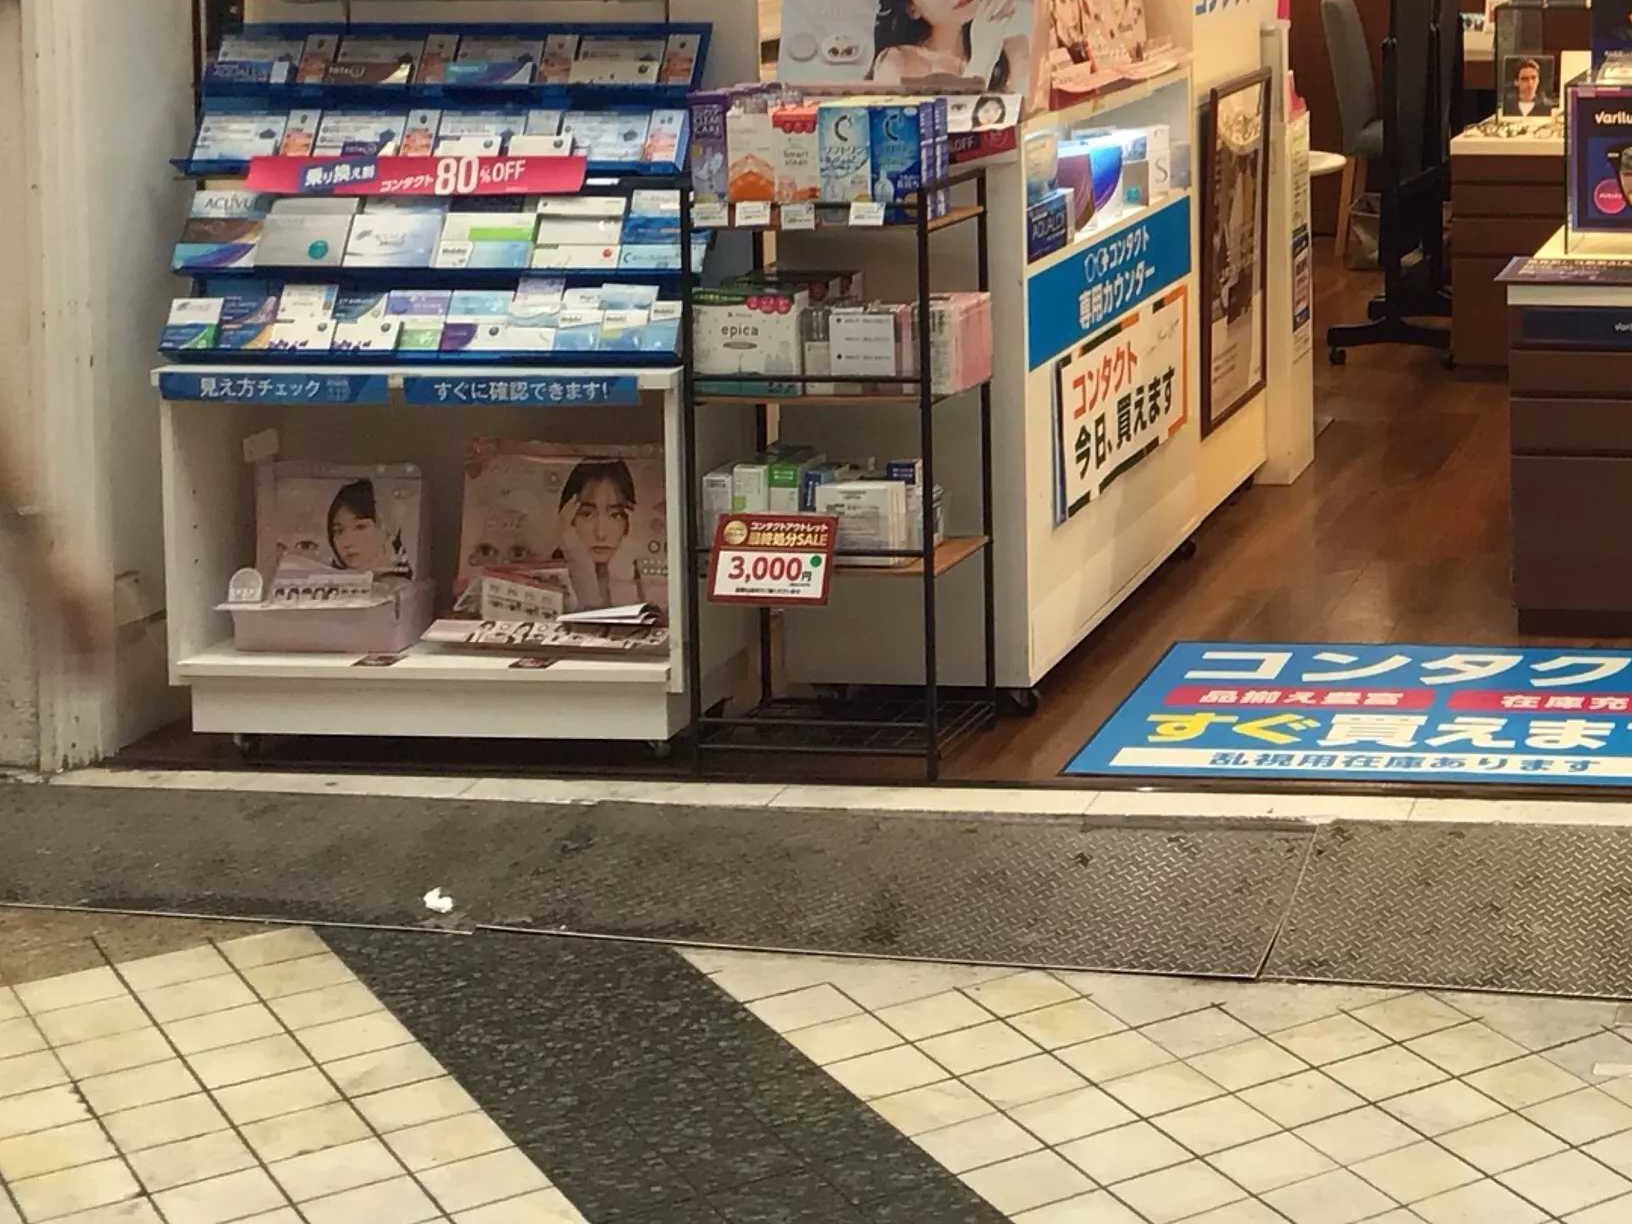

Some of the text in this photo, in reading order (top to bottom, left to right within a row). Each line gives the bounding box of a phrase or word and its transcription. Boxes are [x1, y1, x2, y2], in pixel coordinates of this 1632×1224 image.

[304, 163, 376, 188] 乗り換え割
[1110, 225, 1150, 270] コンタクト
[1079, 266, 1156, 329] 専用カウンター
[721, 325, 760, 338] epica
[200, 377, 321, 398] 見え方チェック
[434, 380, 609, 403] すぐに確認できます!
[1073, 342, 1138, 420] コンタクト
[1074, 366, 1176, 480] 今日、買えます
[1199, 689, 1405, 707] 品揃え豊富
[1208, 750, 1602, 774] 乱視用在庫あります
